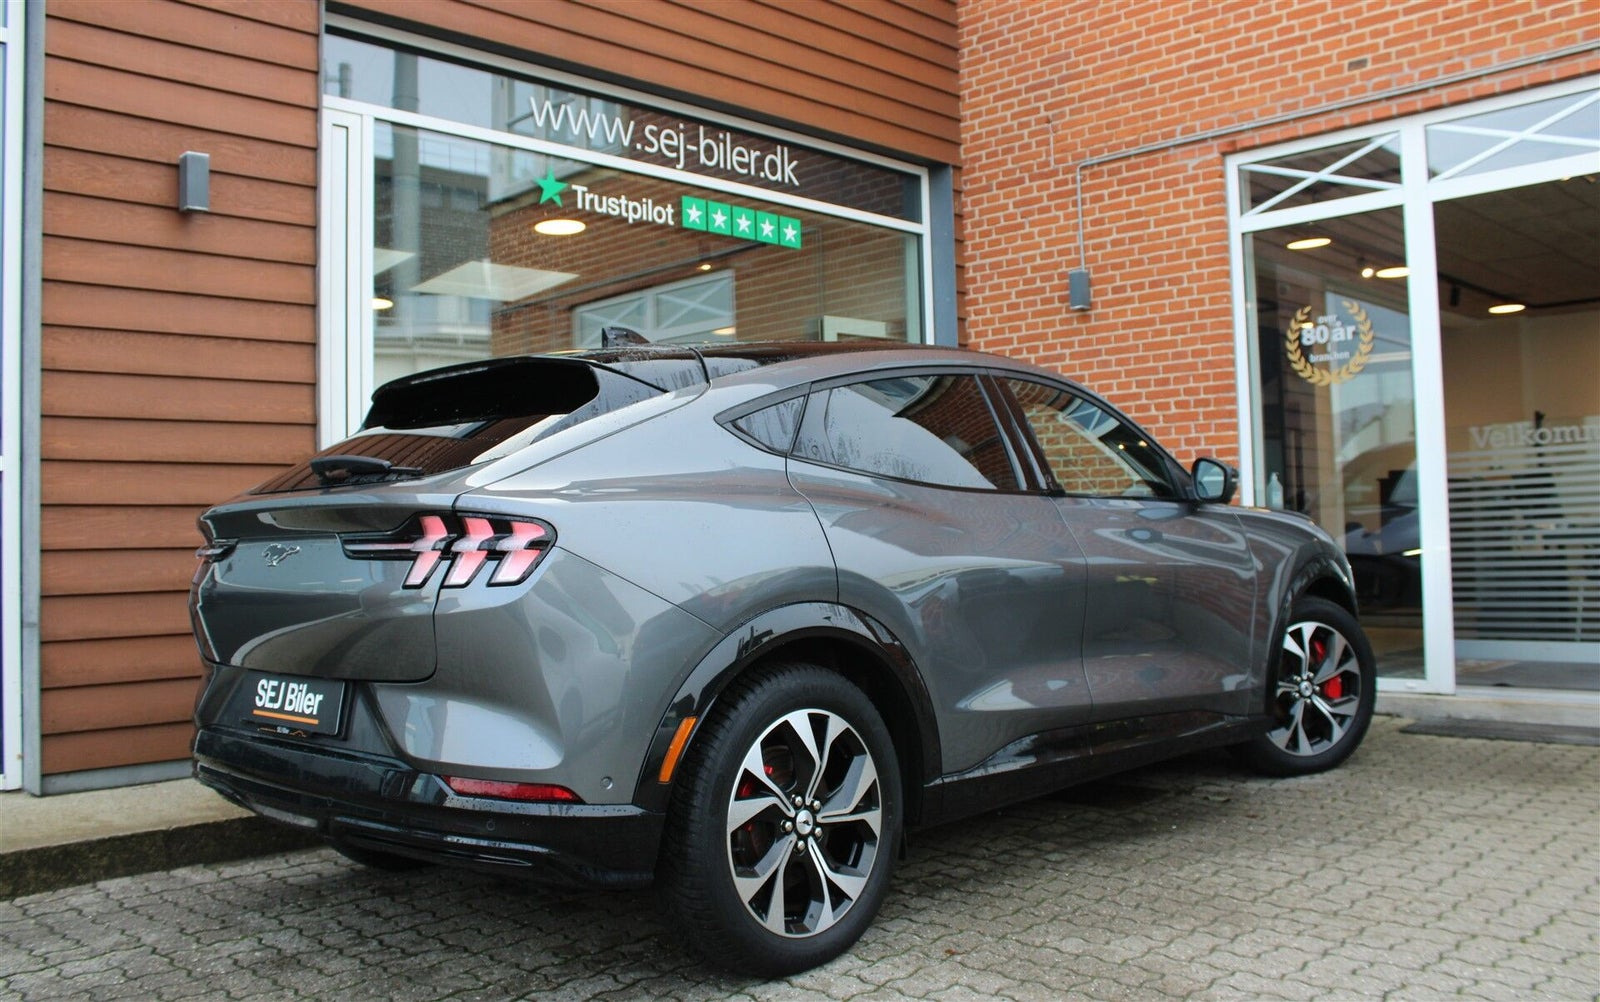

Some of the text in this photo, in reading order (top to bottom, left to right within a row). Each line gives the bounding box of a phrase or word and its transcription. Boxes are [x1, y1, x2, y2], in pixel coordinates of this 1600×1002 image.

[530, 97, 799, 186] www.sej-biler.dk
[571, 184, 675, 226] Trustpilot
[1301, 321, 1356, 346] 80 år
[255, 678, 324, 715] SEJ Biler
